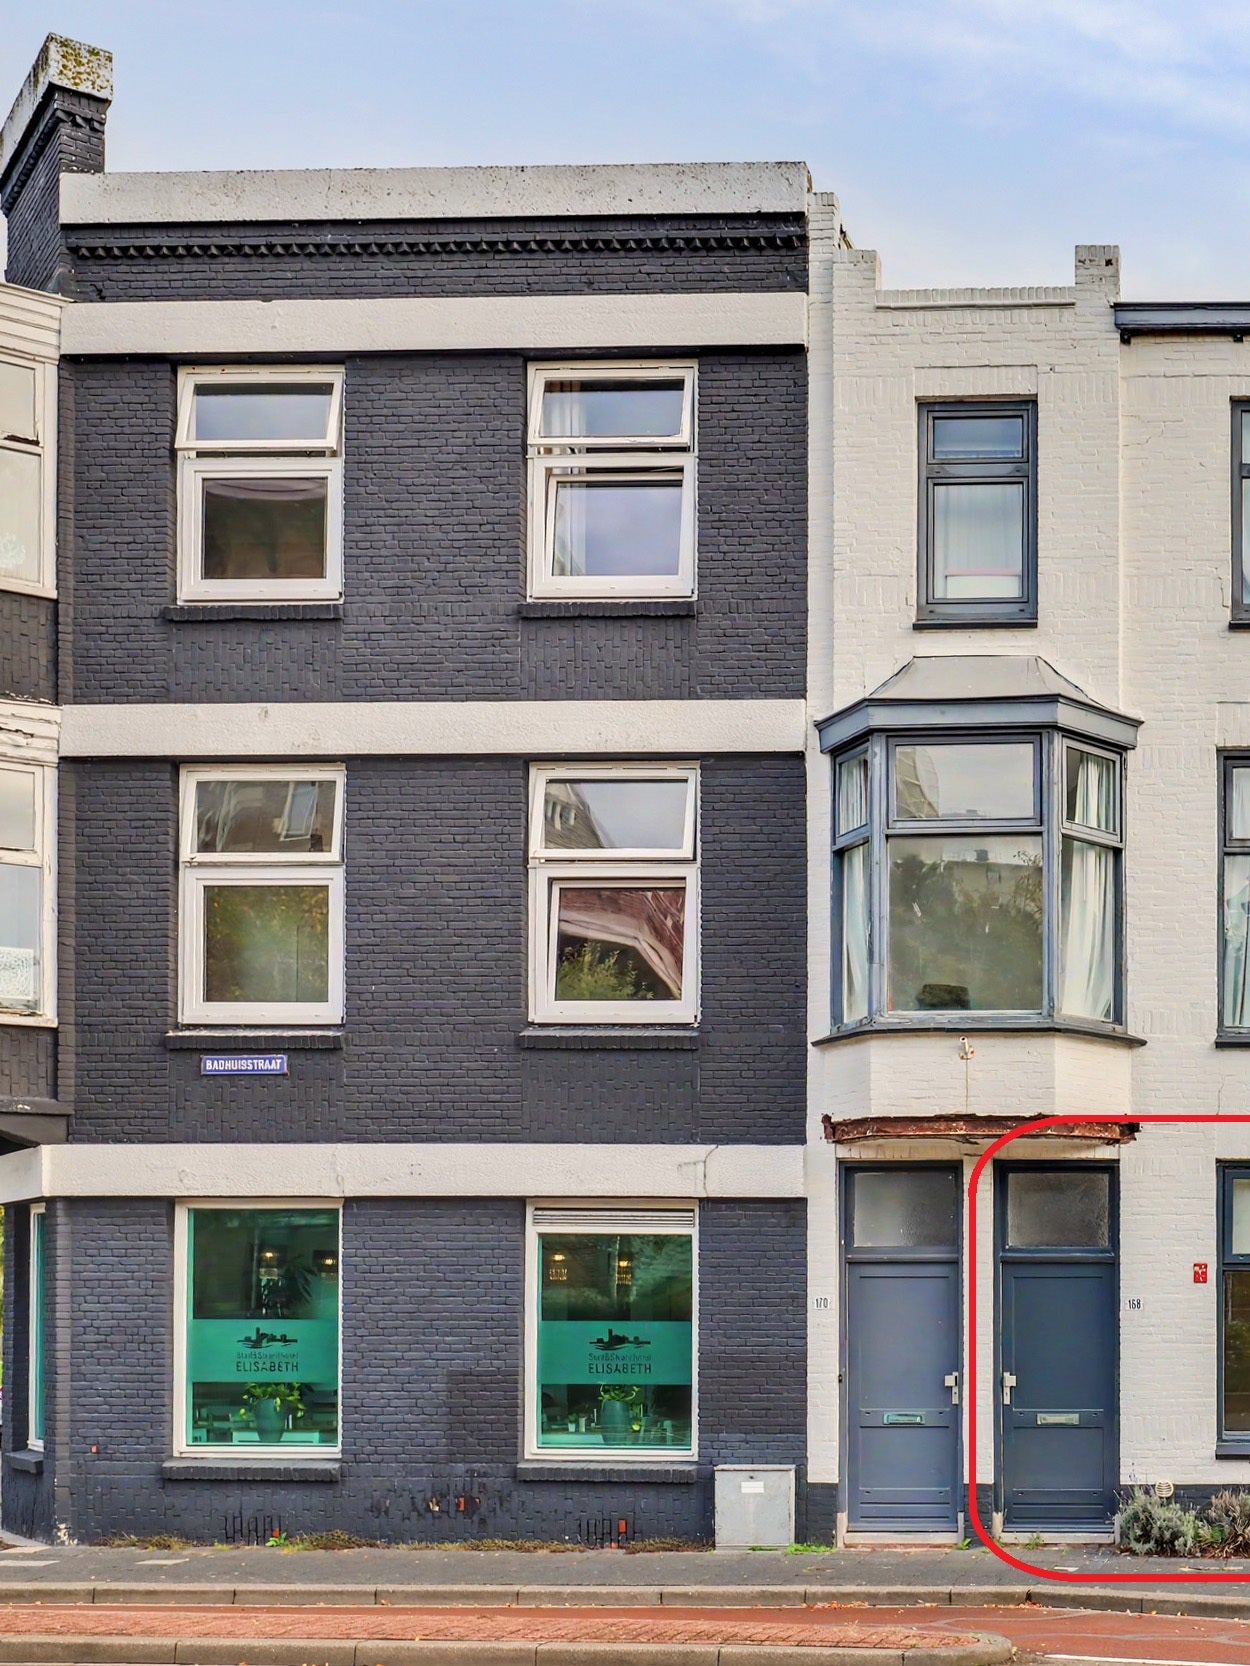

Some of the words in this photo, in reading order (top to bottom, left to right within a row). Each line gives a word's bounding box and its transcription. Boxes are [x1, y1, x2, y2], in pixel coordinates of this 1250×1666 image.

[205, 1059, 282, 1070] BADHUISSTRAAT
[815, 1297, 829, 1309] 170
[1128, 1298, 1142, 1310] 168
[236, 1361, 299, 1372] ELISABETH
[588, 1362, 652, 1374] ELISABETH
